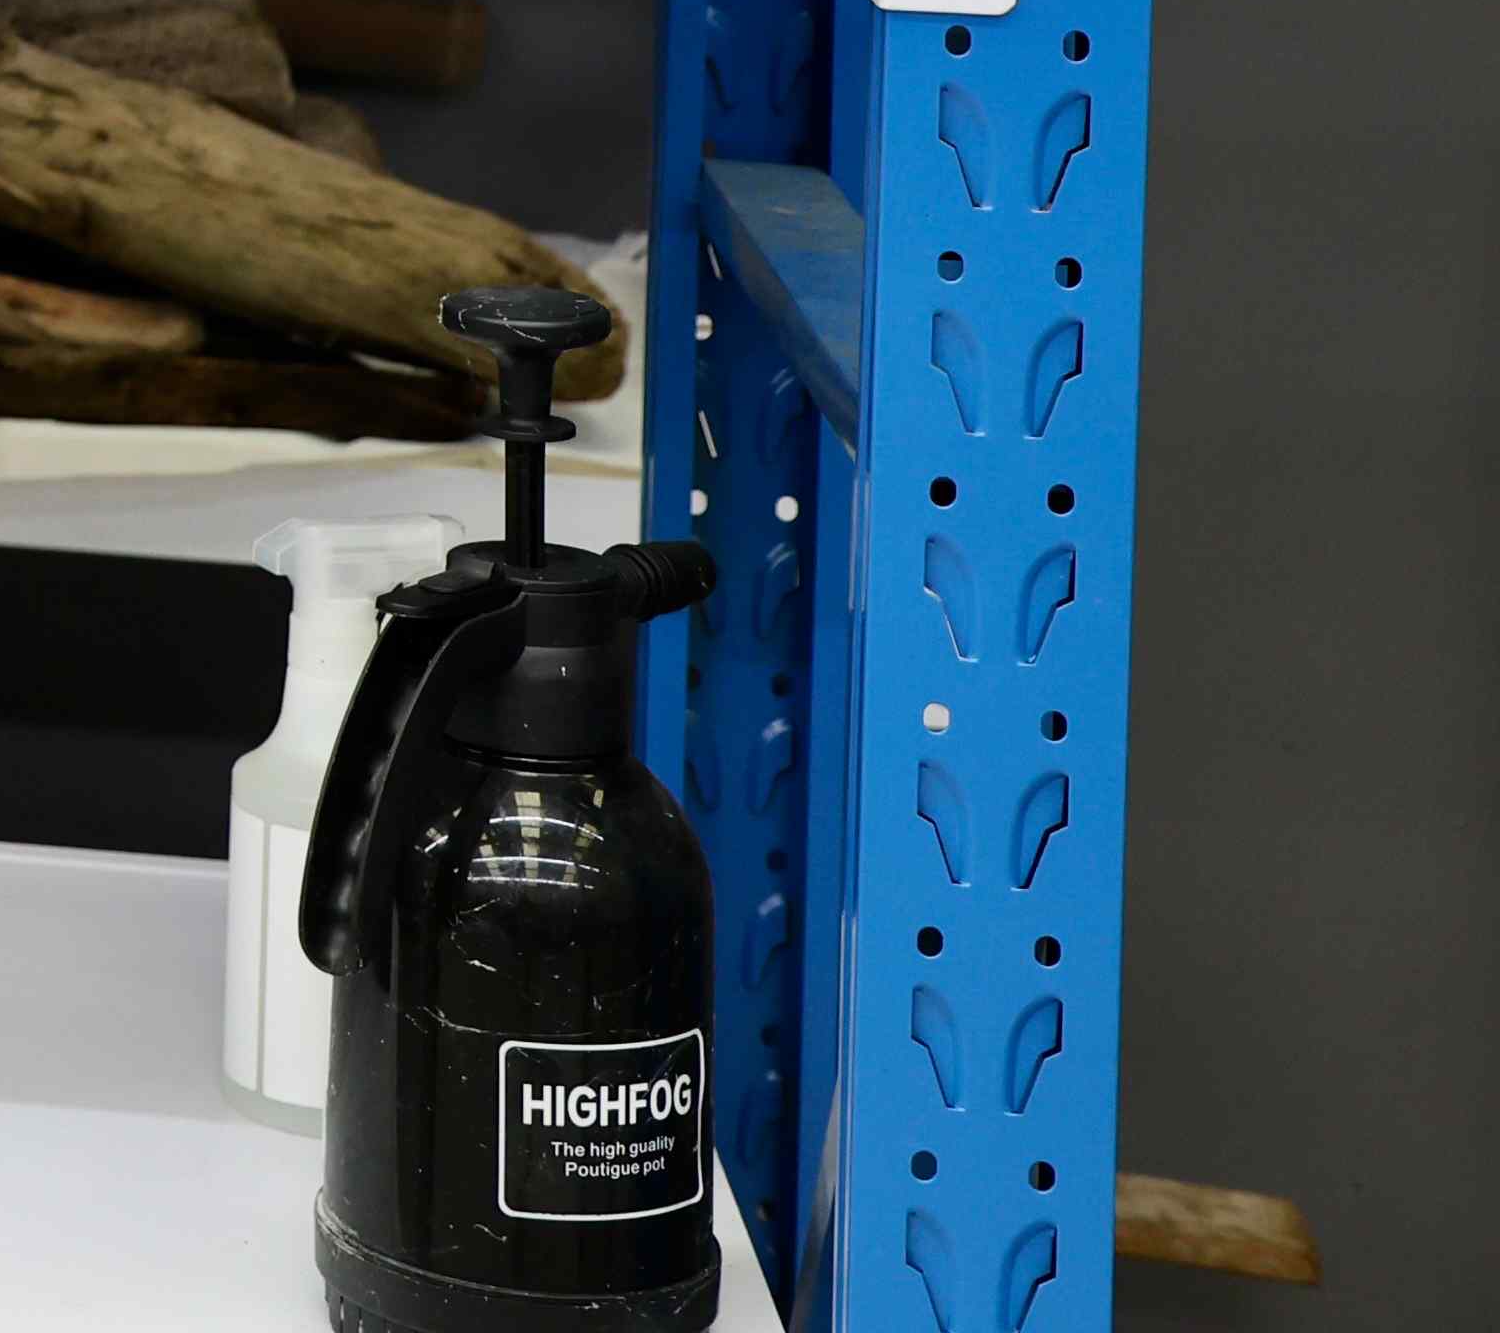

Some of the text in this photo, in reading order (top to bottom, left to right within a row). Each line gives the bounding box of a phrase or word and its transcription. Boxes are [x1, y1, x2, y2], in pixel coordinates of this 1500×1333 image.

[522, 1073, 692, 1128] HIGHFOG
[550, 1141, 586, 1158] The
[589, 1141, 626, 1160] high
[564, 1156, 666, 1180] Poutigue pot
